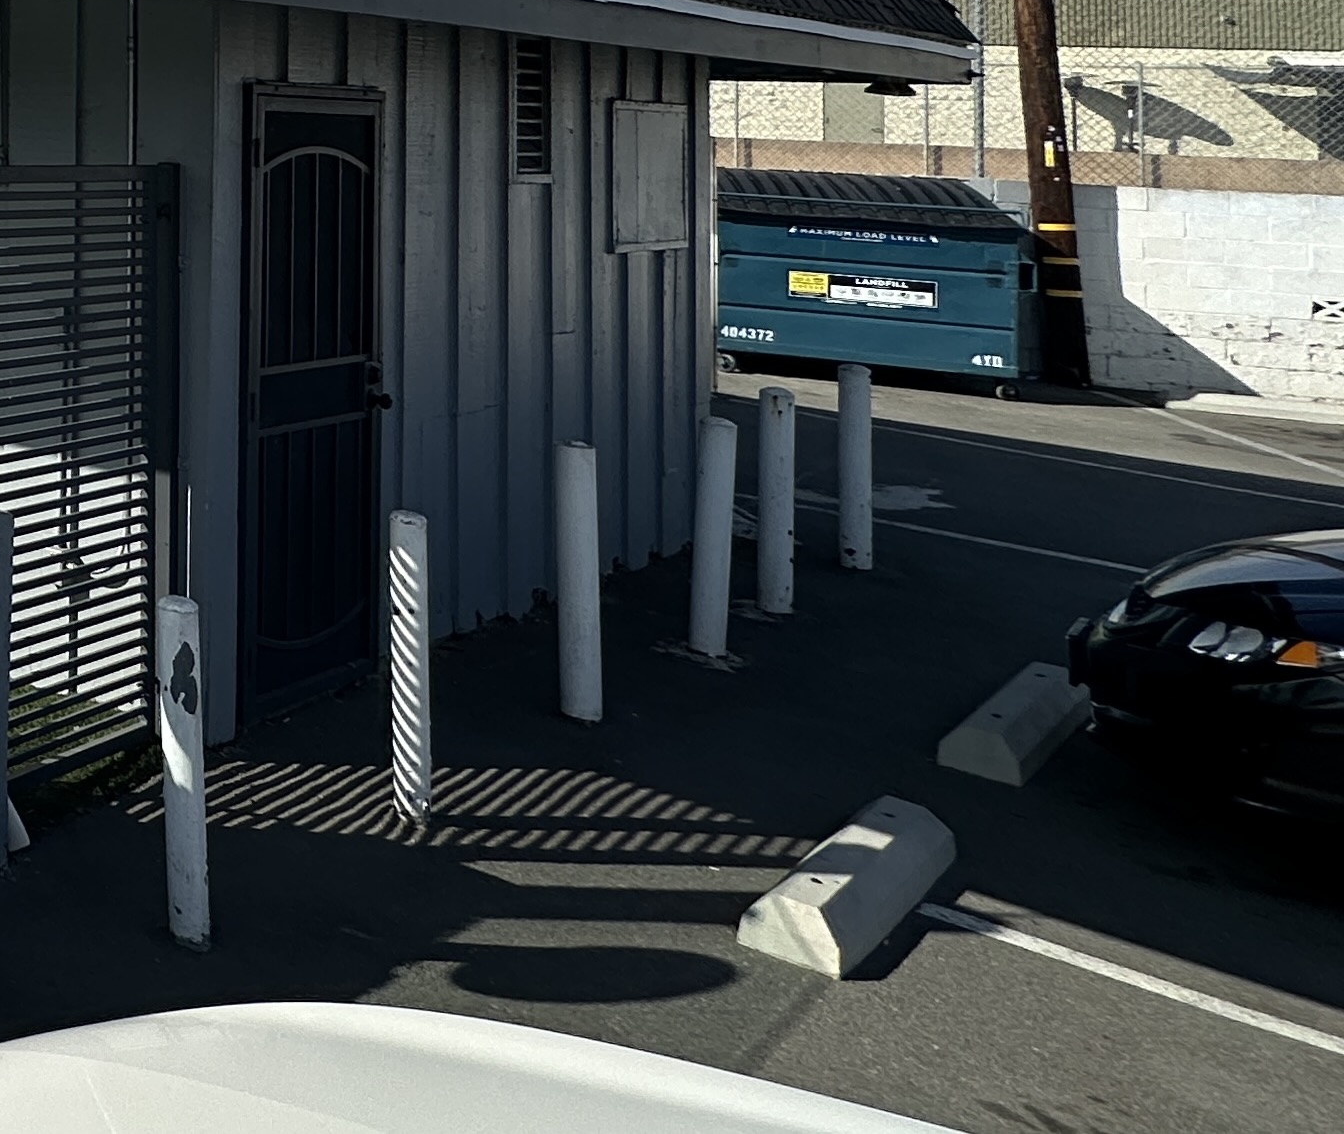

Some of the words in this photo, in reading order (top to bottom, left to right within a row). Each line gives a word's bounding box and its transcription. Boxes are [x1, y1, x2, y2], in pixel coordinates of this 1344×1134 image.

[799, 228, 853, 237] MAXIMUM
[855, 231, 887, 240] LOAD
[890, 234, 927, 243] LEVEL
[854, 277, 909, 289] LANDFILL
[720, 325, 775, 342] 404372
